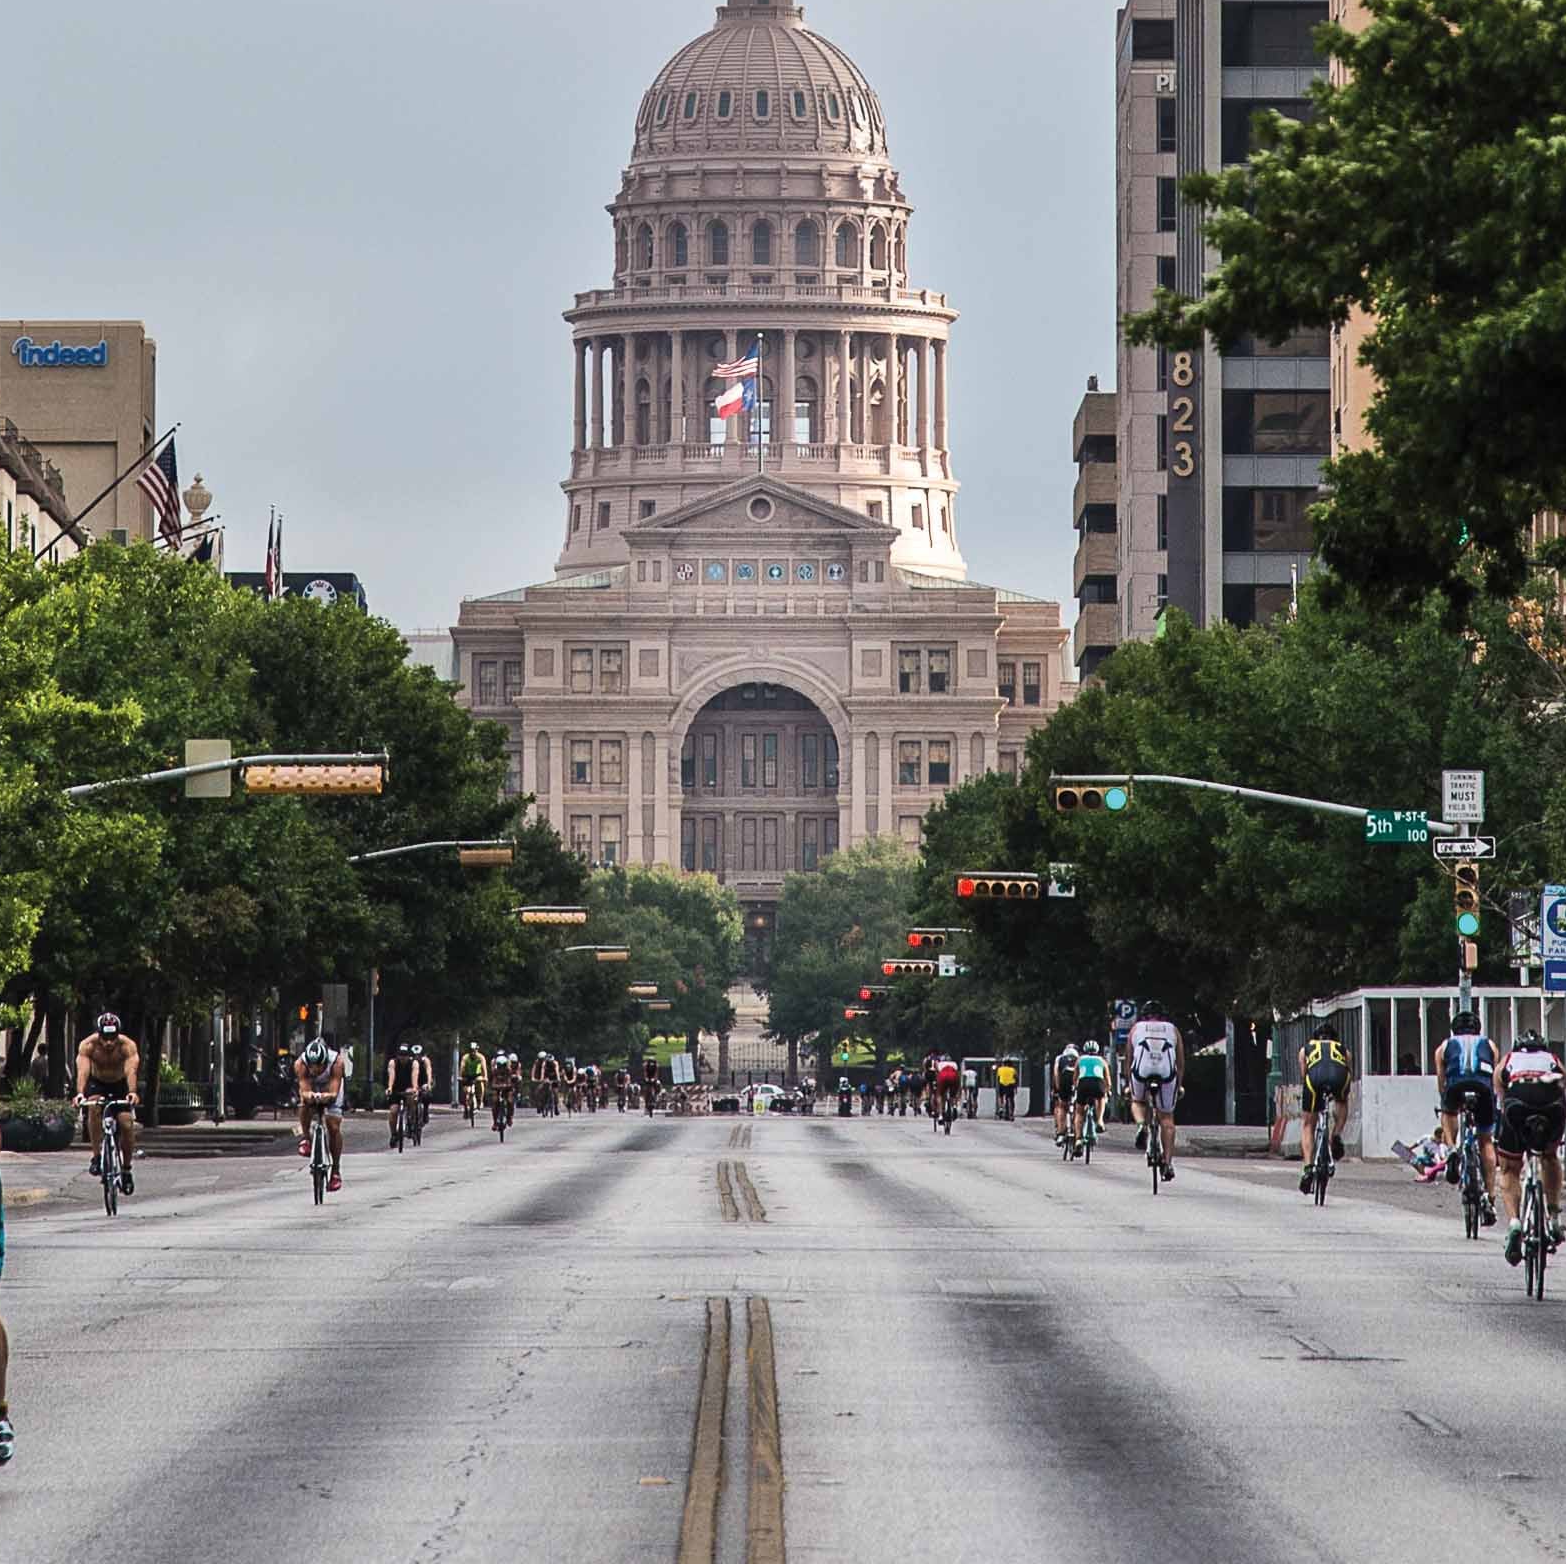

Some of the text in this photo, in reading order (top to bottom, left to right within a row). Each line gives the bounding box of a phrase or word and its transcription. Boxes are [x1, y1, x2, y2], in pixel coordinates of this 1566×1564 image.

[13, 337, 107, 365] indeed
[1172, 351, 1194, 478] 823
[1451, 791, 1475, 801] MUST
[1366, 814, 1393, 837] 5th
[1407, 829, 1427, 842] 100
